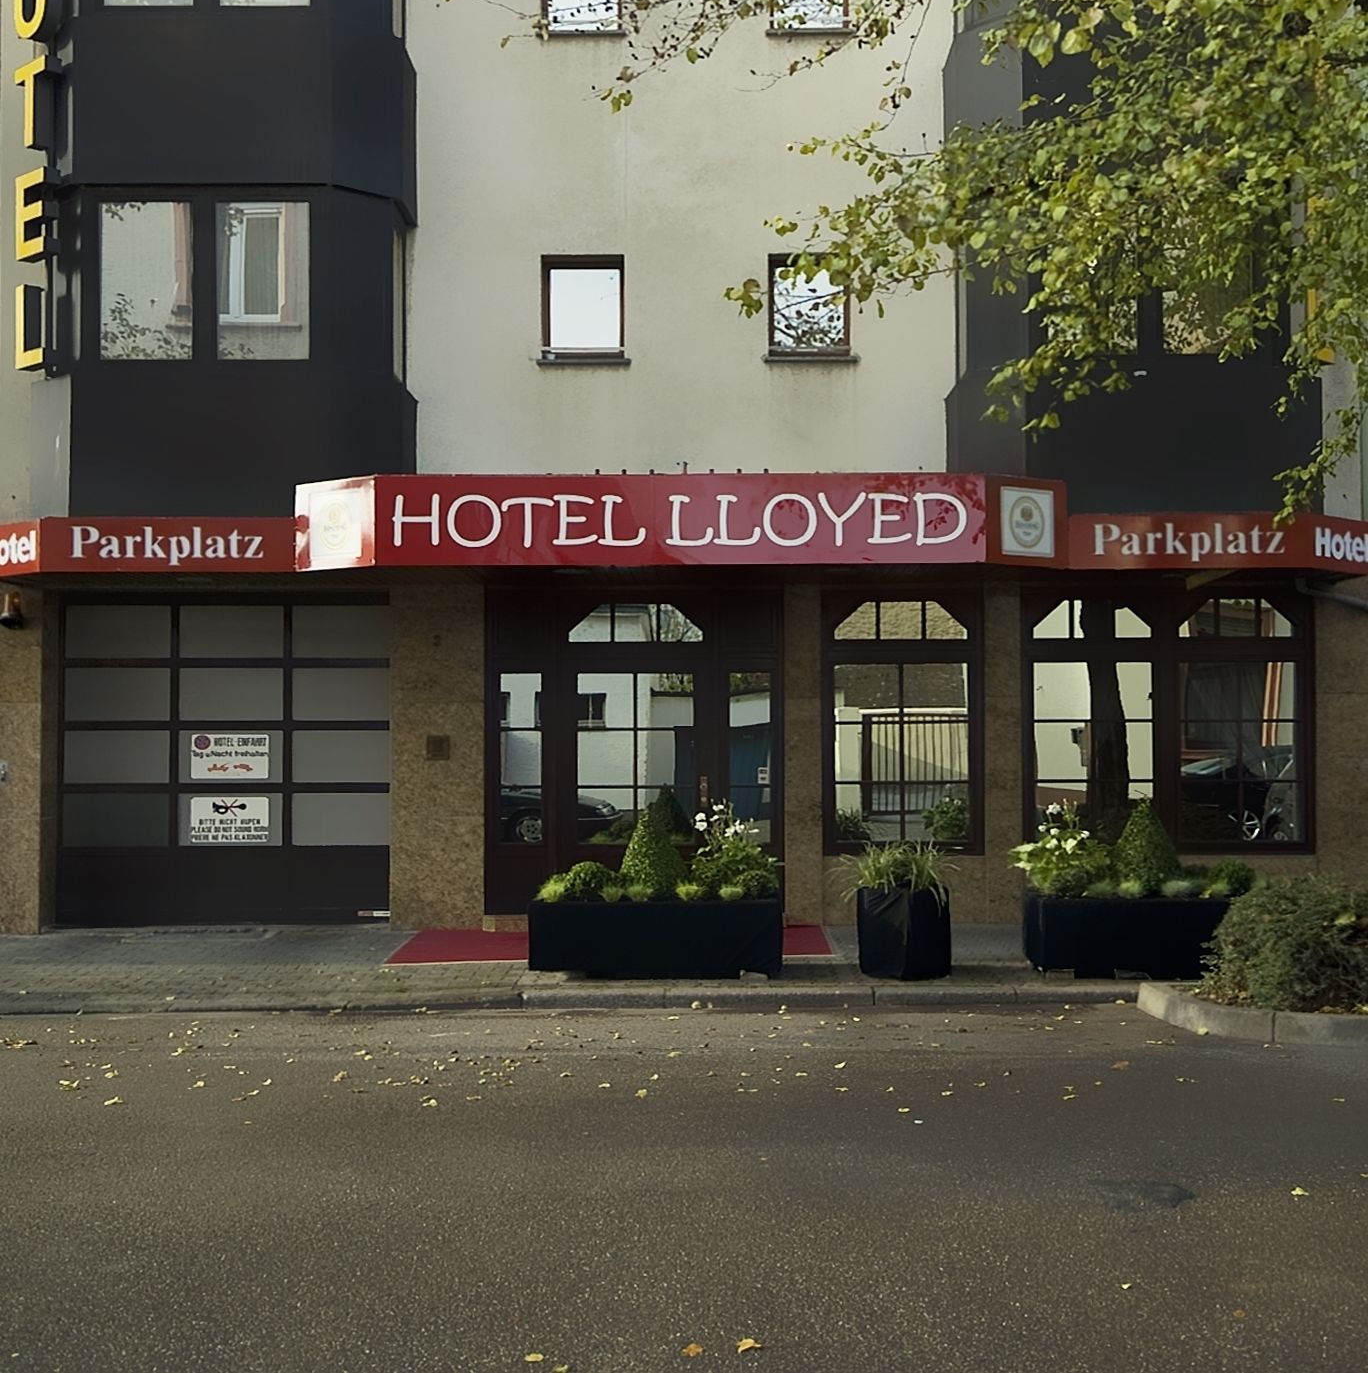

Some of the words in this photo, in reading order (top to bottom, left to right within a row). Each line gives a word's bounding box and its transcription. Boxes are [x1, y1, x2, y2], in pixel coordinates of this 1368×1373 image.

[392, 493, 647, 548] HOTEL
[665, 491, 968, 547] LLOYED
[70, 525, 264, 566] Parkplatz
[1094, 522, 1286, 562] Parkplatz
